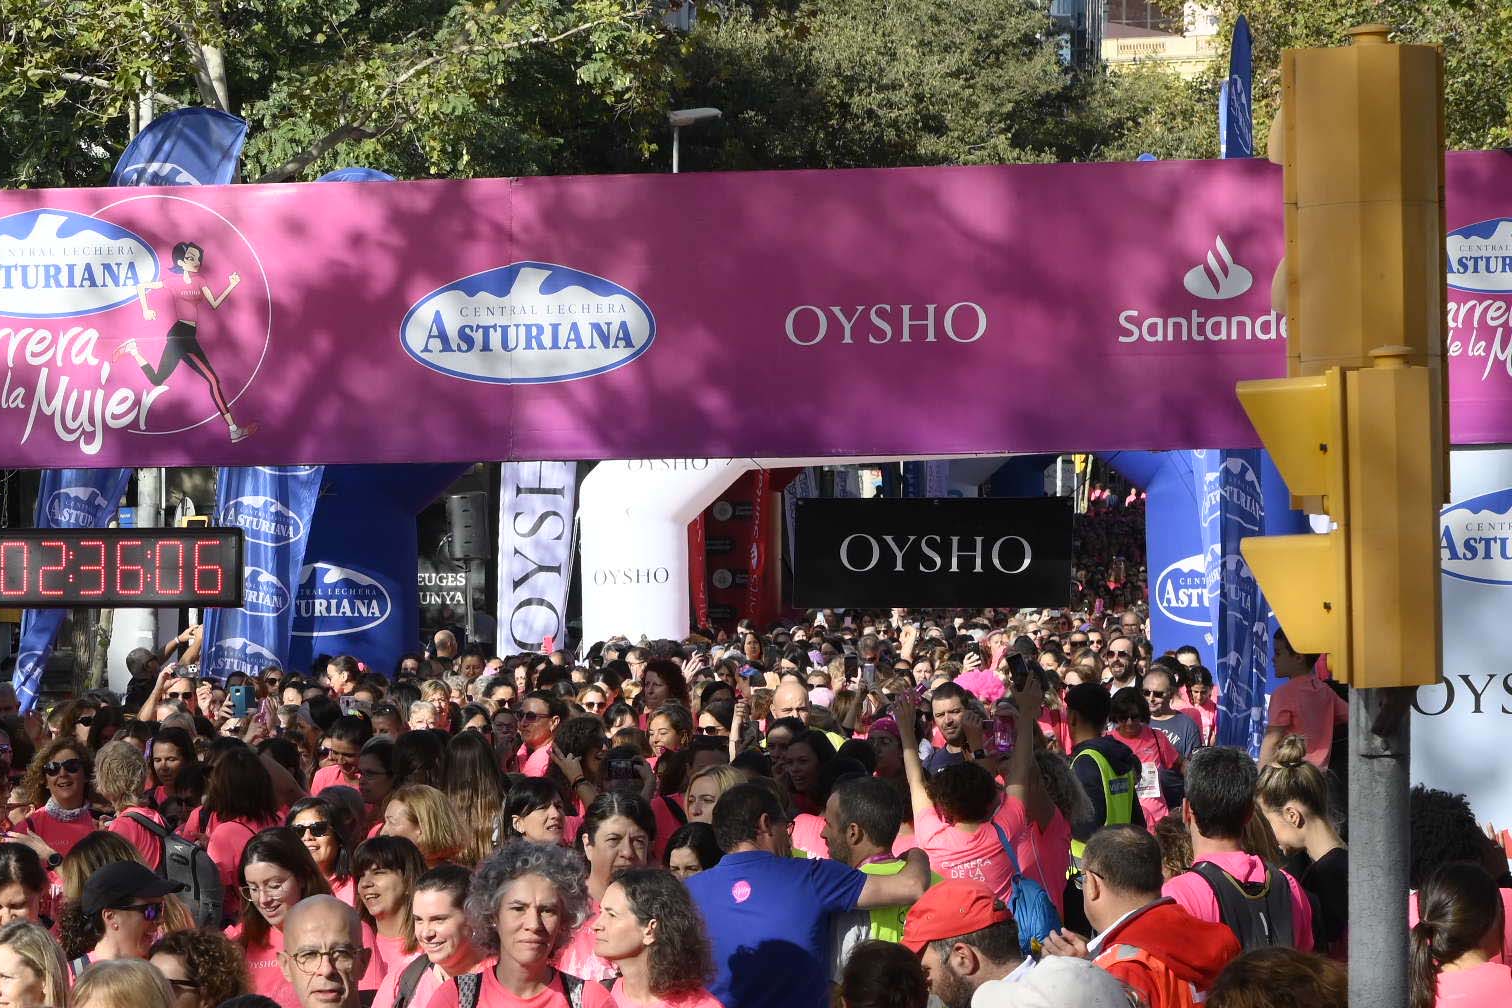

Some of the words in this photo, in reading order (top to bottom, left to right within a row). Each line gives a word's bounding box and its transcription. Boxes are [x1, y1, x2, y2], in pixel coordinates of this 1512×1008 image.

[61, 244, 135, 258] LECHERA
[419, 309, 636, 354] ASTURIANA
[459, 304, 539, 318] CENTRAL
[546, 302, 627, 316] LECHERA
[785, 301, 988, 345] OYSHO
[0, 370, 25, 410] la
[21, 362, 170, 455] Mujer
[0, 540, 222, 595] 02:36:06
[839, 532, 1033, 575] OYSHO
[593, 567, 670, 585] OYSHO
[951, 870, 967, 879] DE
[969, 869, 984, 879] LA
